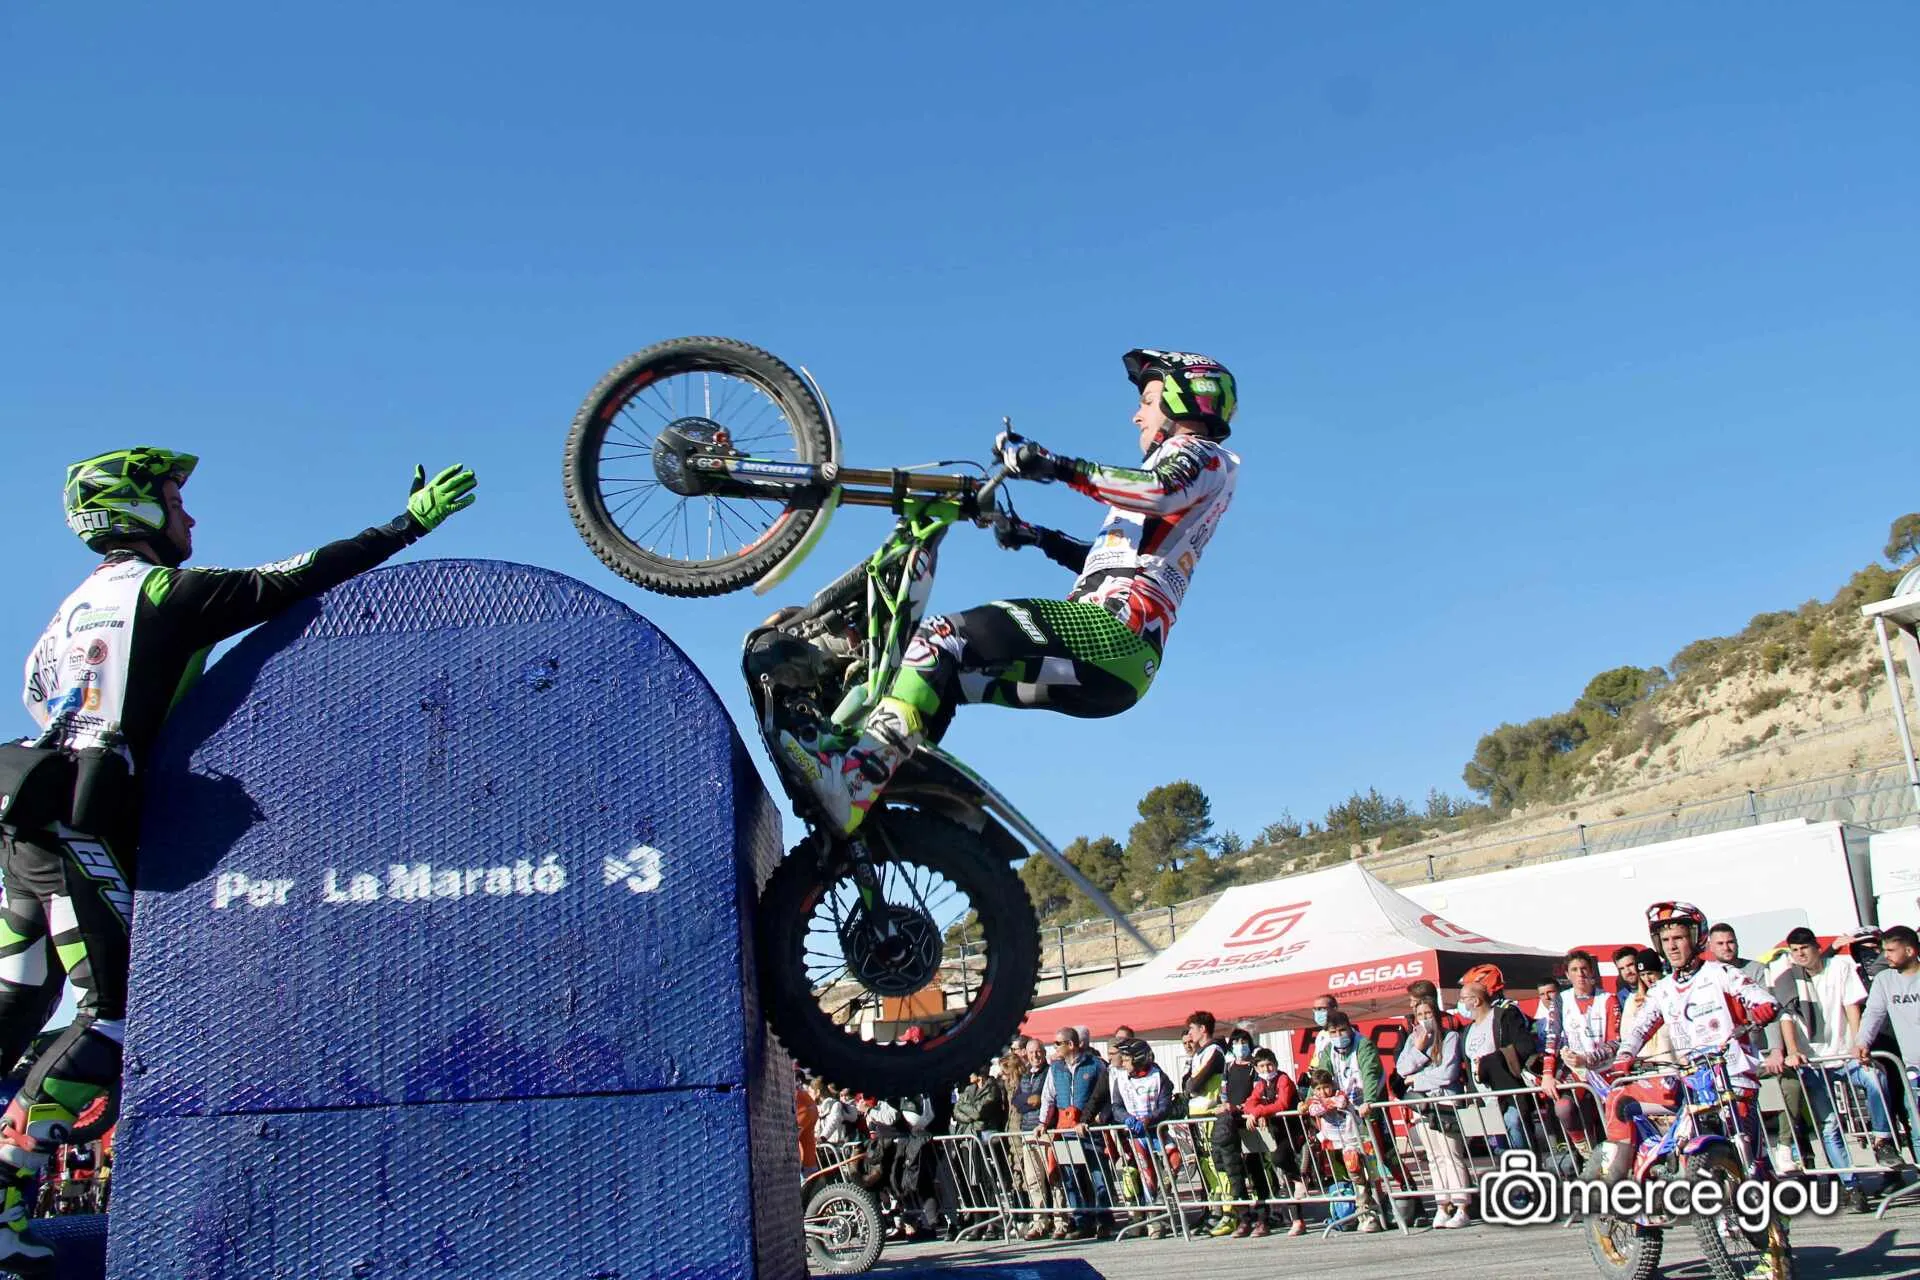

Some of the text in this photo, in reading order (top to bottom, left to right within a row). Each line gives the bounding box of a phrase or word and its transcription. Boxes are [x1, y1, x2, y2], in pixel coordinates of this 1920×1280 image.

[741, 462, 809, 475] MICHELIN
[215, 872, 295, 908] Per
[323, 869, 378, 902] La
[387, 854, 568, 900] Marató
[1176, 940, 1311, 971] GASGAS
[1328, 960, 1423, 989] GASGAS
